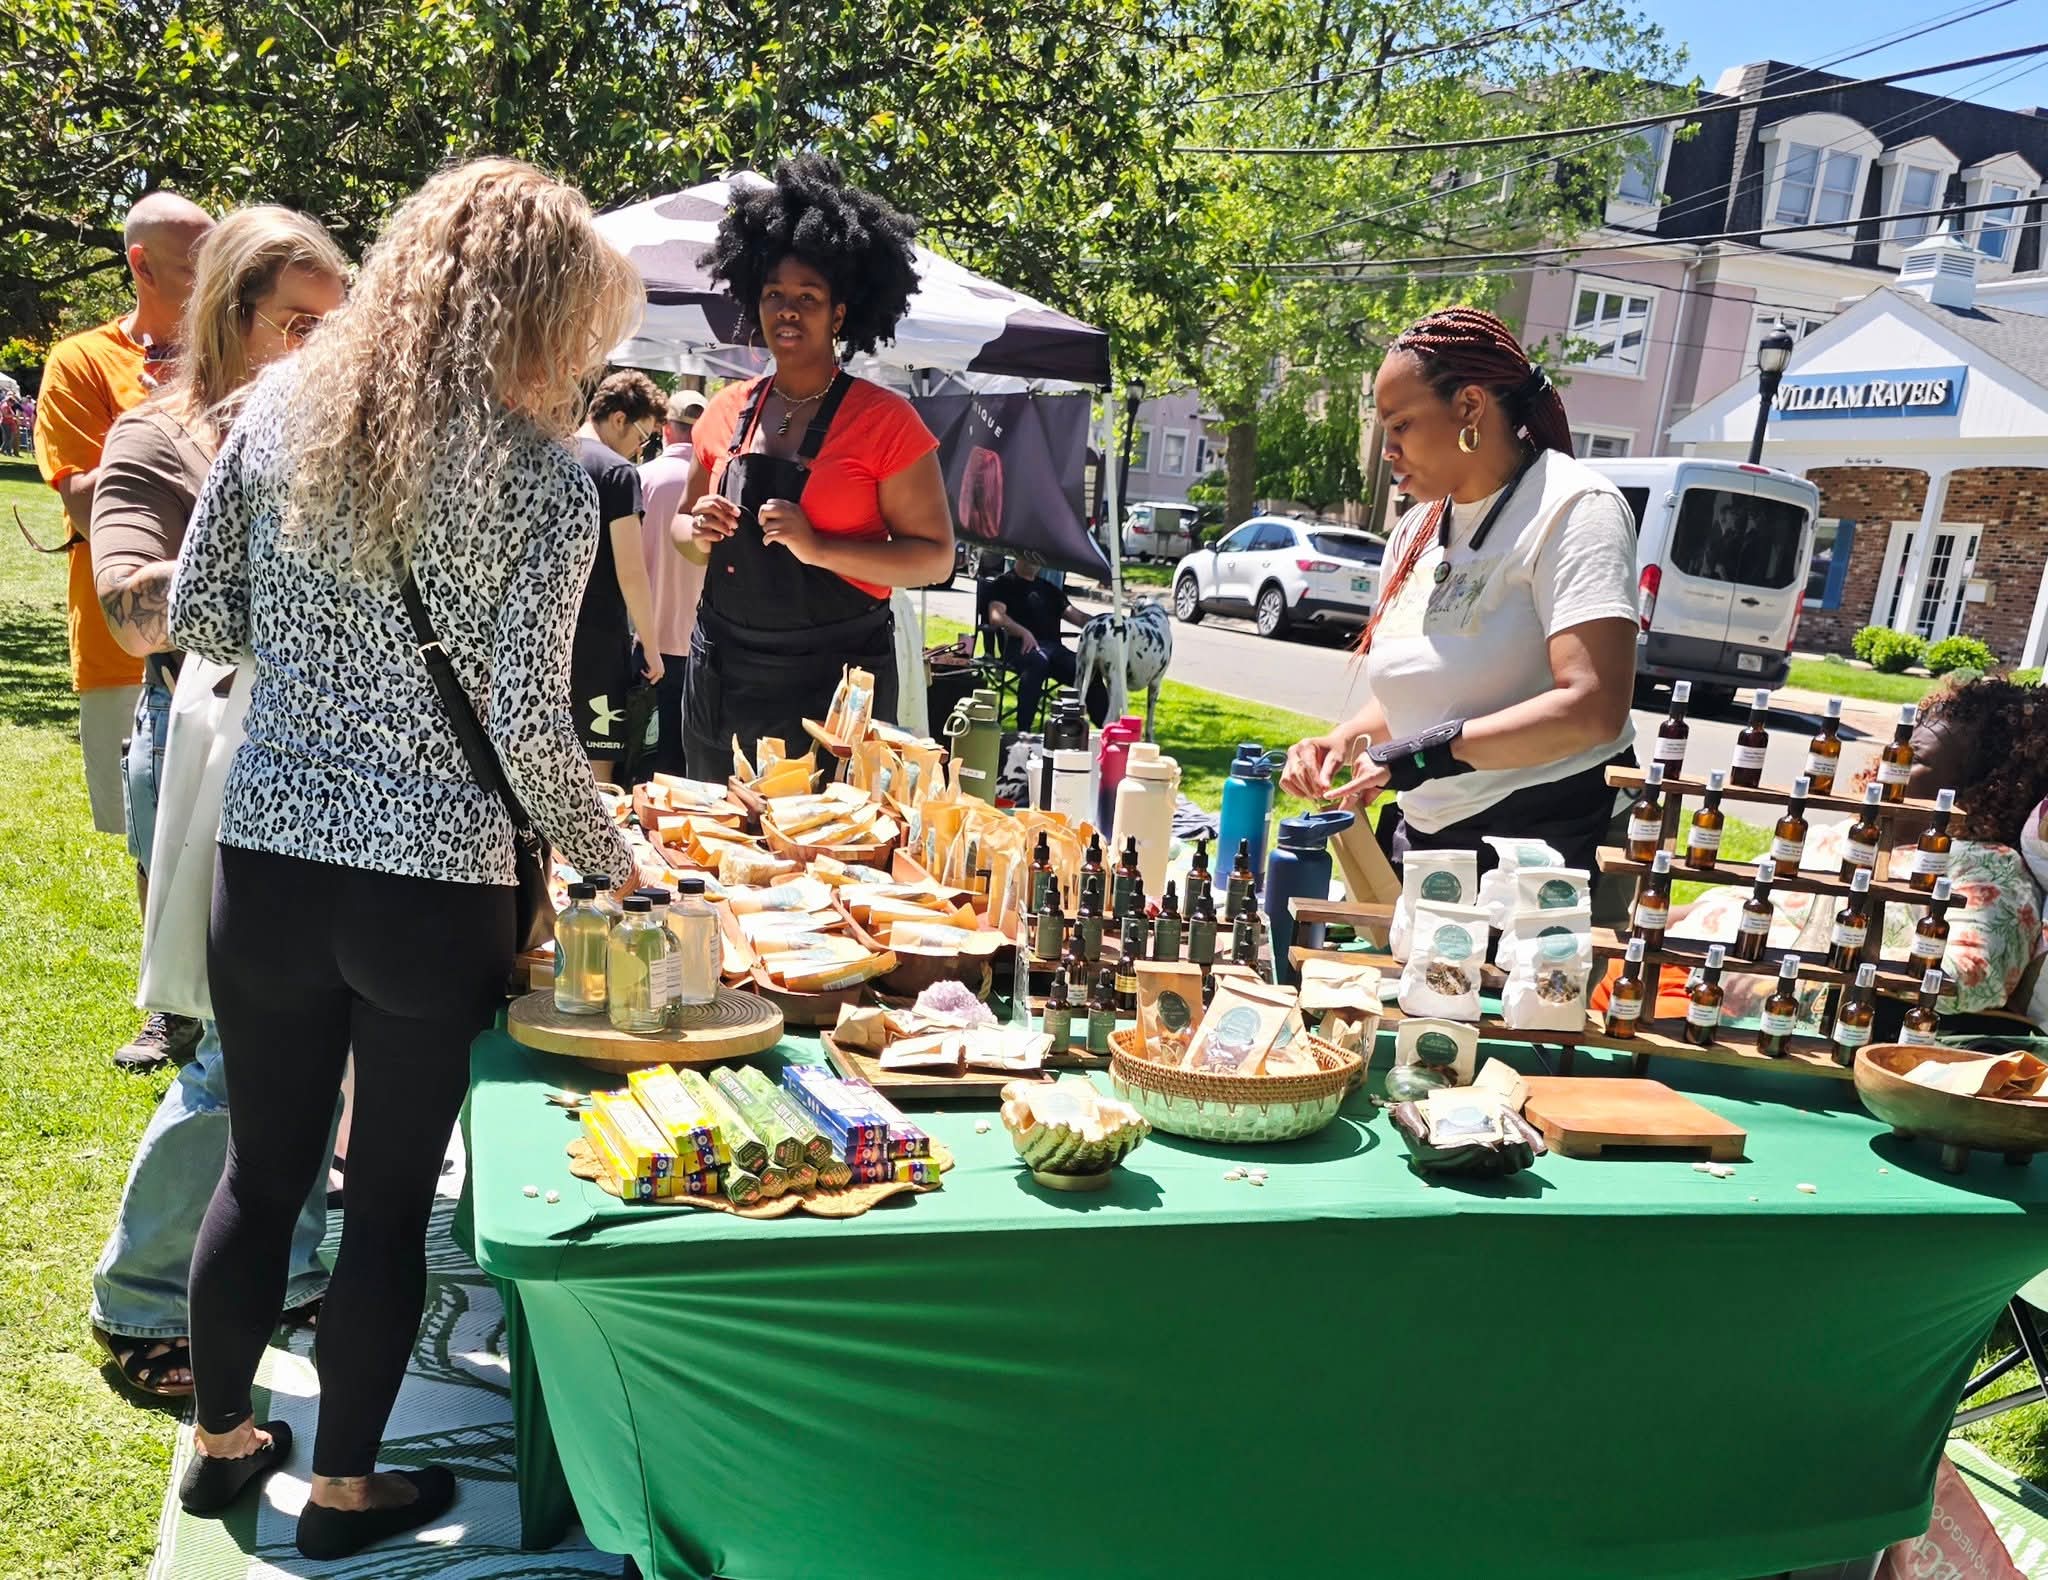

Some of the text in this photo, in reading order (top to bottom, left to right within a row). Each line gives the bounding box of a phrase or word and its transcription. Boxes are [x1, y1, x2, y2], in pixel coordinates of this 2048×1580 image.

[1772, 379, 1948, 411] WILLIAM RAVEIS
[586, 740, 621, 750] UNDER
[1932, 1505, 1991, 1580] HOMEGOO
